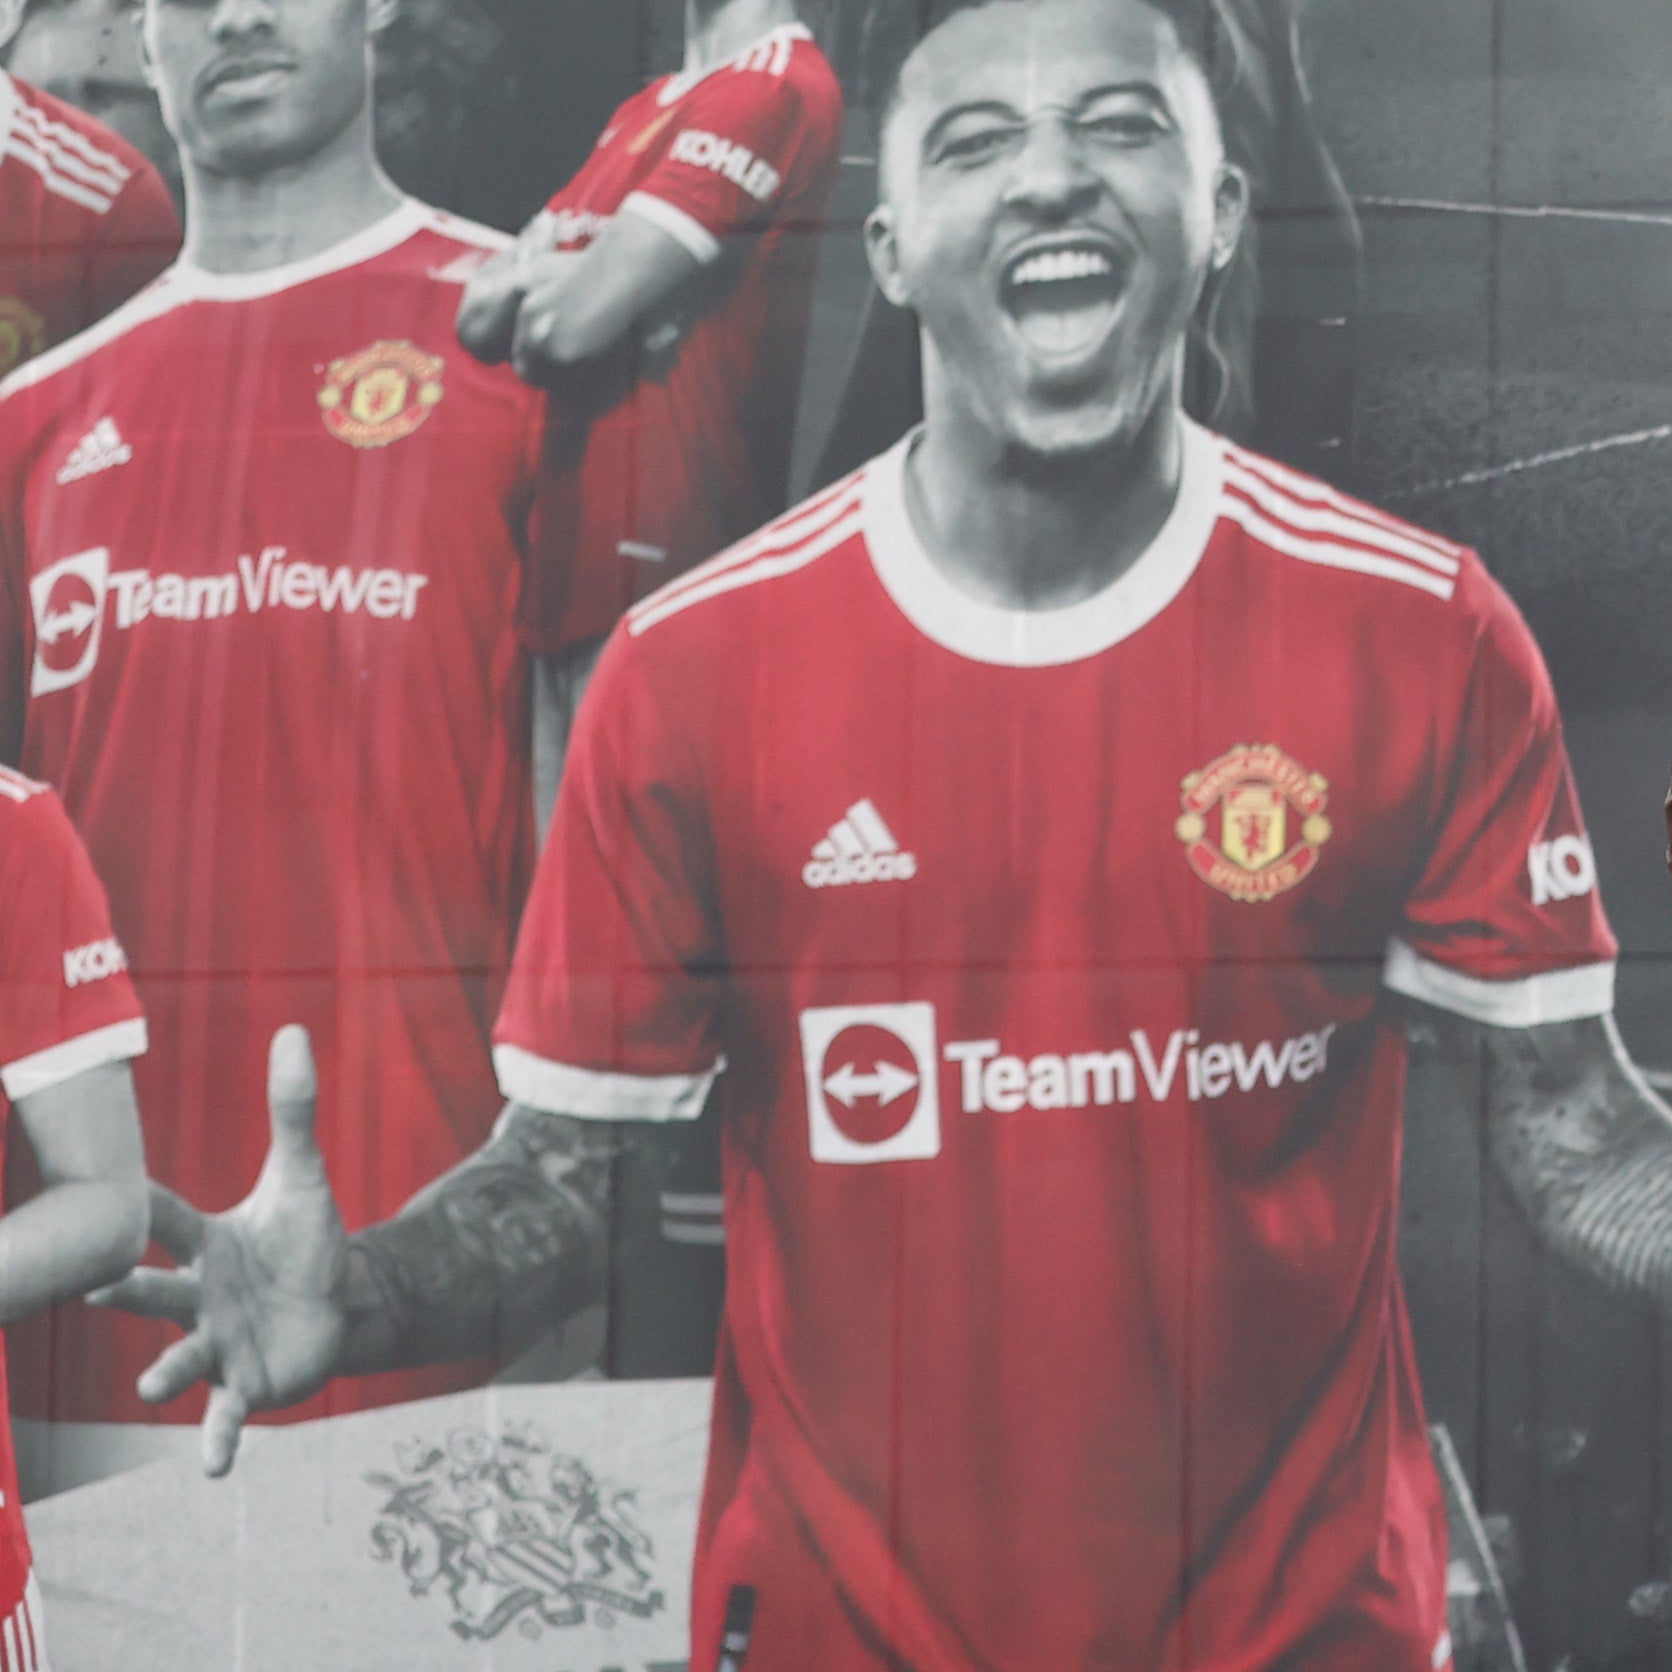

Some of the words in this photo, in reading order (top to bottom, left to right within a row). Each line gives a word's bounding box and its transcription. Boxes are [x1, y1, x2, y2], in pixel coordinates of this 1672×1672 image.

[107, 548, 426, 628] TeamViewer
[801, 851, 917, 889] adidas
[945, 1024, 1338, 1114] TeamViewer
